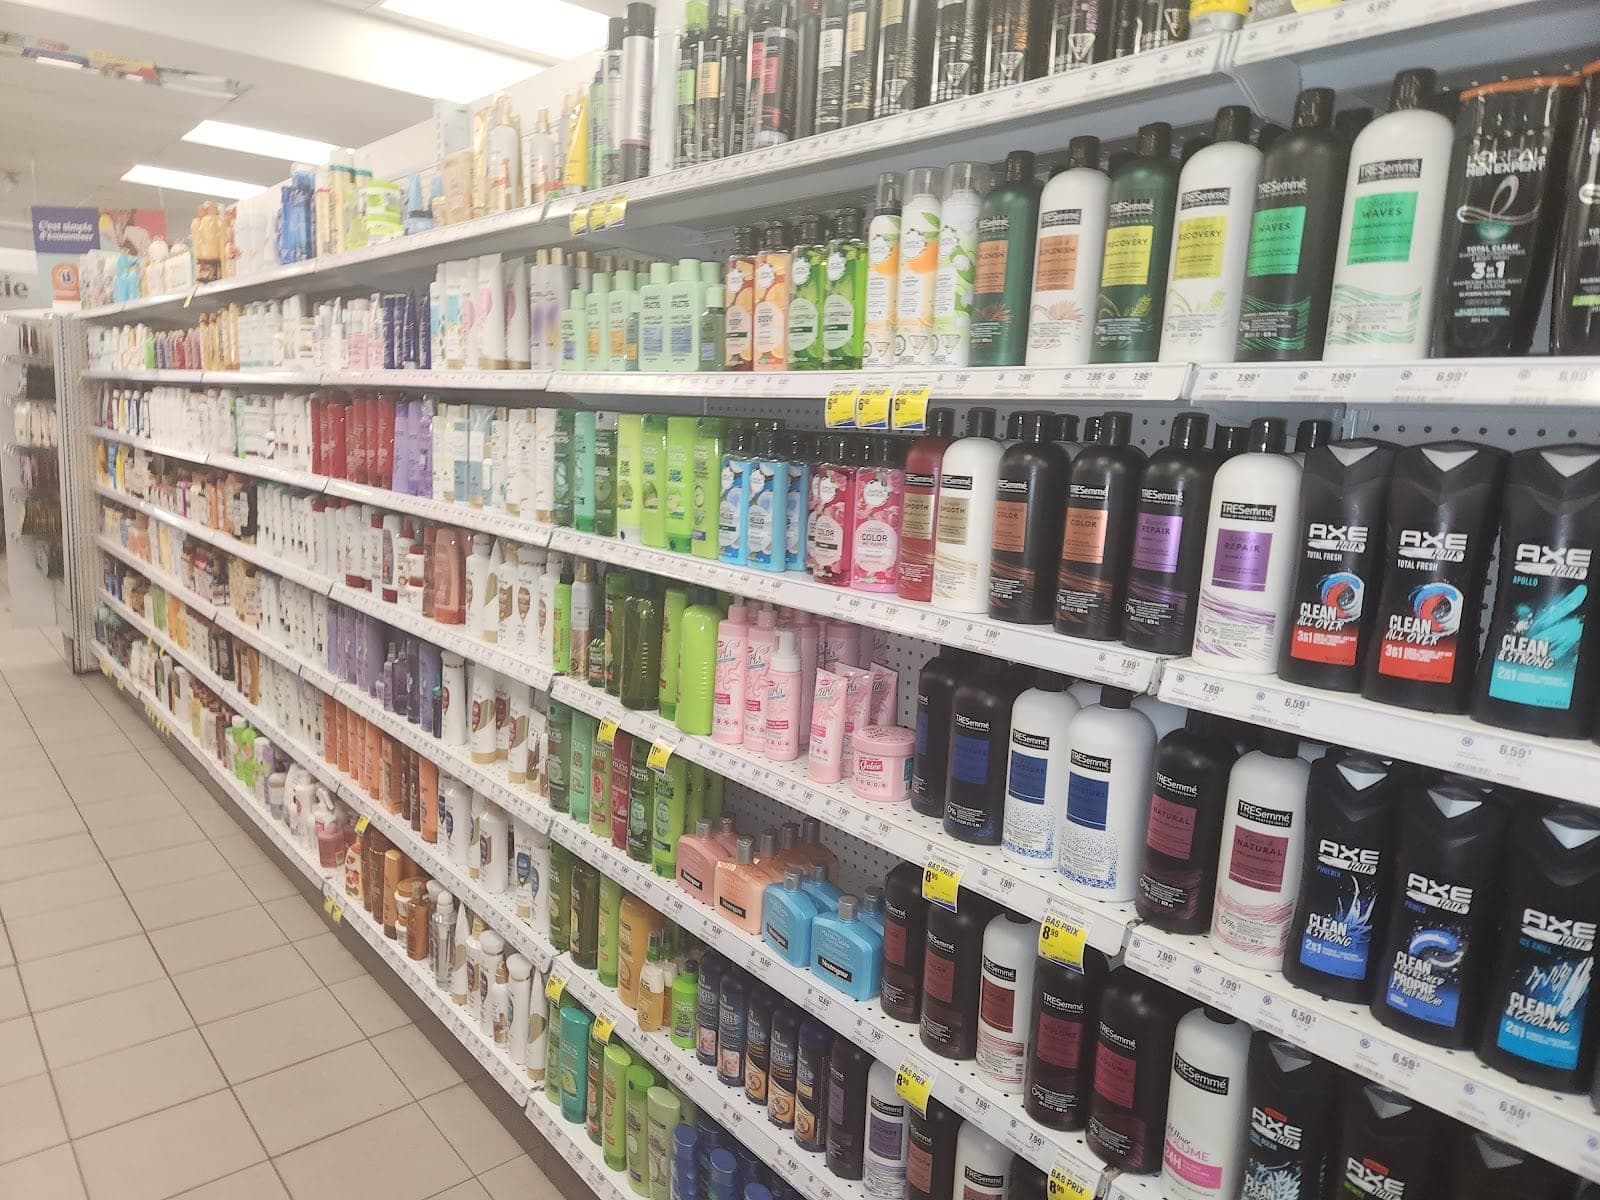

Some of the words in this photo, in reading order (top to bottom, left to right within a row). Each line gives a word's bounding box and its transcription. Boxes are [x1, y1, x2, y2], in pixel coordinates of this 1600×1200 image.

[1494, 159, 1546, 174] EXPERT
[1362, 208, 1402, 219] WAVES
[1141, 488, 1184, 502] TRESemmé
[1222, 503, 1275, 518] TRESemmé
[1070, 519, 1097, 528] COLOR
[1142, 525, 1170, 535] REPAIR
[1309, 523, 1369, 542] AXE
[861, 534, 888, 543] COLOR
[1224, 542, 1260, 553] REPAIR
[1400, 530, 1469, 550] AXE
[1307, 551, 1322, 560] TOTAL
[1323, 553, 1342, 562] FRESH
[1516, 543, 1593, 567] AXE
[1398, 559, 1415, 569] TOTAL
[1416, 561, 1438, 571] FRESH
[1512, 575, 1538, 587] APOLLO
[1300, 602, 1338, 620] CLEAN
[1297, 616, 1313, 627] ALL
[1315, 620, 1345, 632] OVER
[1389, 615, 1431, 634] CLEAN
[1385, 630, 1404, 641] ALL
[1406, 632, 1440, 647] OVER
[1501, 634, 1548, 657] CLEAN
[956, 713, 991, 730] TRESemmé
[1013, 730, 1049, 746] TRESemmé
[1071, 750, 1110, 768] TRESemmé
[1156, 772, 1198, 794] TRESemmé
[1153, 806, 1190, 824] NATURAL
[1239, 801, 1290, 822] TRESemmé
[1236, 839, 1282, 857] NATURAL
[1319, 839, 1380, 864] AXE
[927, 861, 939, 872] BAS
[940, 867, 956, 879] PRIX
[1407, 872, 1473, 904] AXE
[1045, 916, 1060, 928] BAS
[1061, 922, 1080, 936] PRIX
[1309, 912, 1347, 937] CLEAN
[1522, 908, 1597, 941] AXE
[1396, 951, 1432, 975] CLEAN
[1393, 971, 1437, 995] PROPRE
[1043, 992, 1084, 1011] TRESemmé
[1509, 991, 1557, 1019] CLEAN
[1100, 1021, 1137, 1047] TRESemmé
[899, 1063, 911, 1076] BAS
[912, 1071, 926, 1086] PRIX
[1176, 1057, 1226, 1088] TRESemmé
[1252, 1107, 1303, 1141] AXE
[1168, 1133, 1209, 1162] VOLUME
[1051, 1169, 1066, 1184] BAS
[1067, 1179, 1085, 1196] PRIX
[1347, 1157, 1406, 1196] AXE
